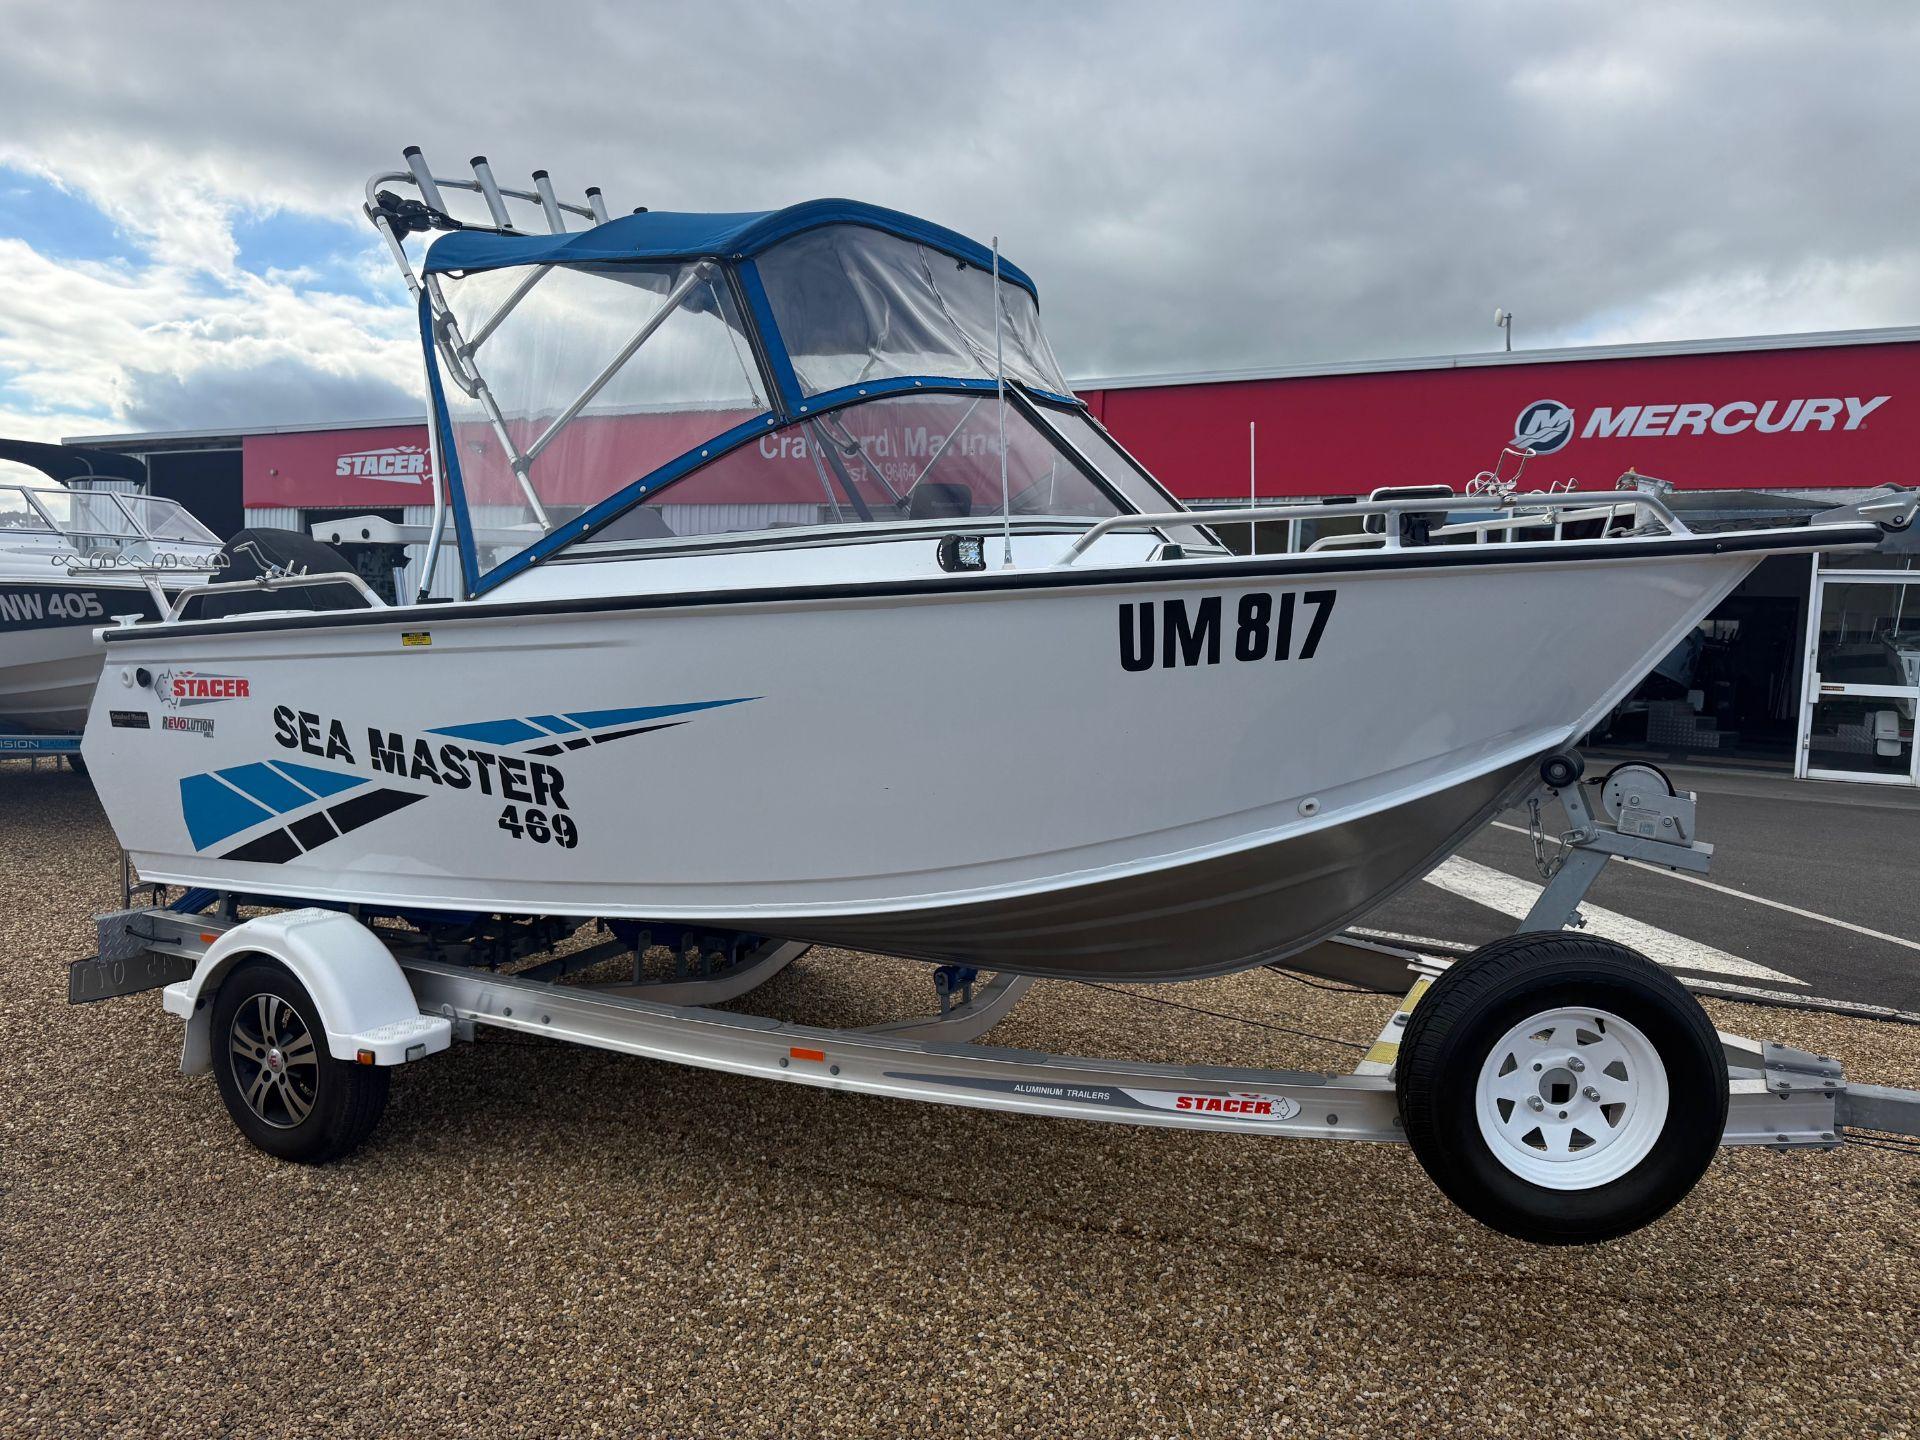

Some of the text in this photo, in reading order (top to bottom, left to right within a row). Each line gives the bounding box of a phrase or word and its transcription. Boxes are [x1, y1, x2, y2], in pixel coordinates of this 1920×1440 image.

[1580, 395, 1892, 439] MERCURY
[336, 454, 425, 475] STACER
[48, 592, 104, 618] 405
[1119, 590, 1337, 671] UM 817
[173, 680, 249, 697] STACER
[162, 716, 215, 732] REVOLUTION
[273, 705, 570, 810] SEA MASTER
[498, 805, 578, 849] 469
[1014, 1083, 1110, 1101] ALUMINIUM TRAILERS
[1176, 1096, 1272, 1115] STACER
